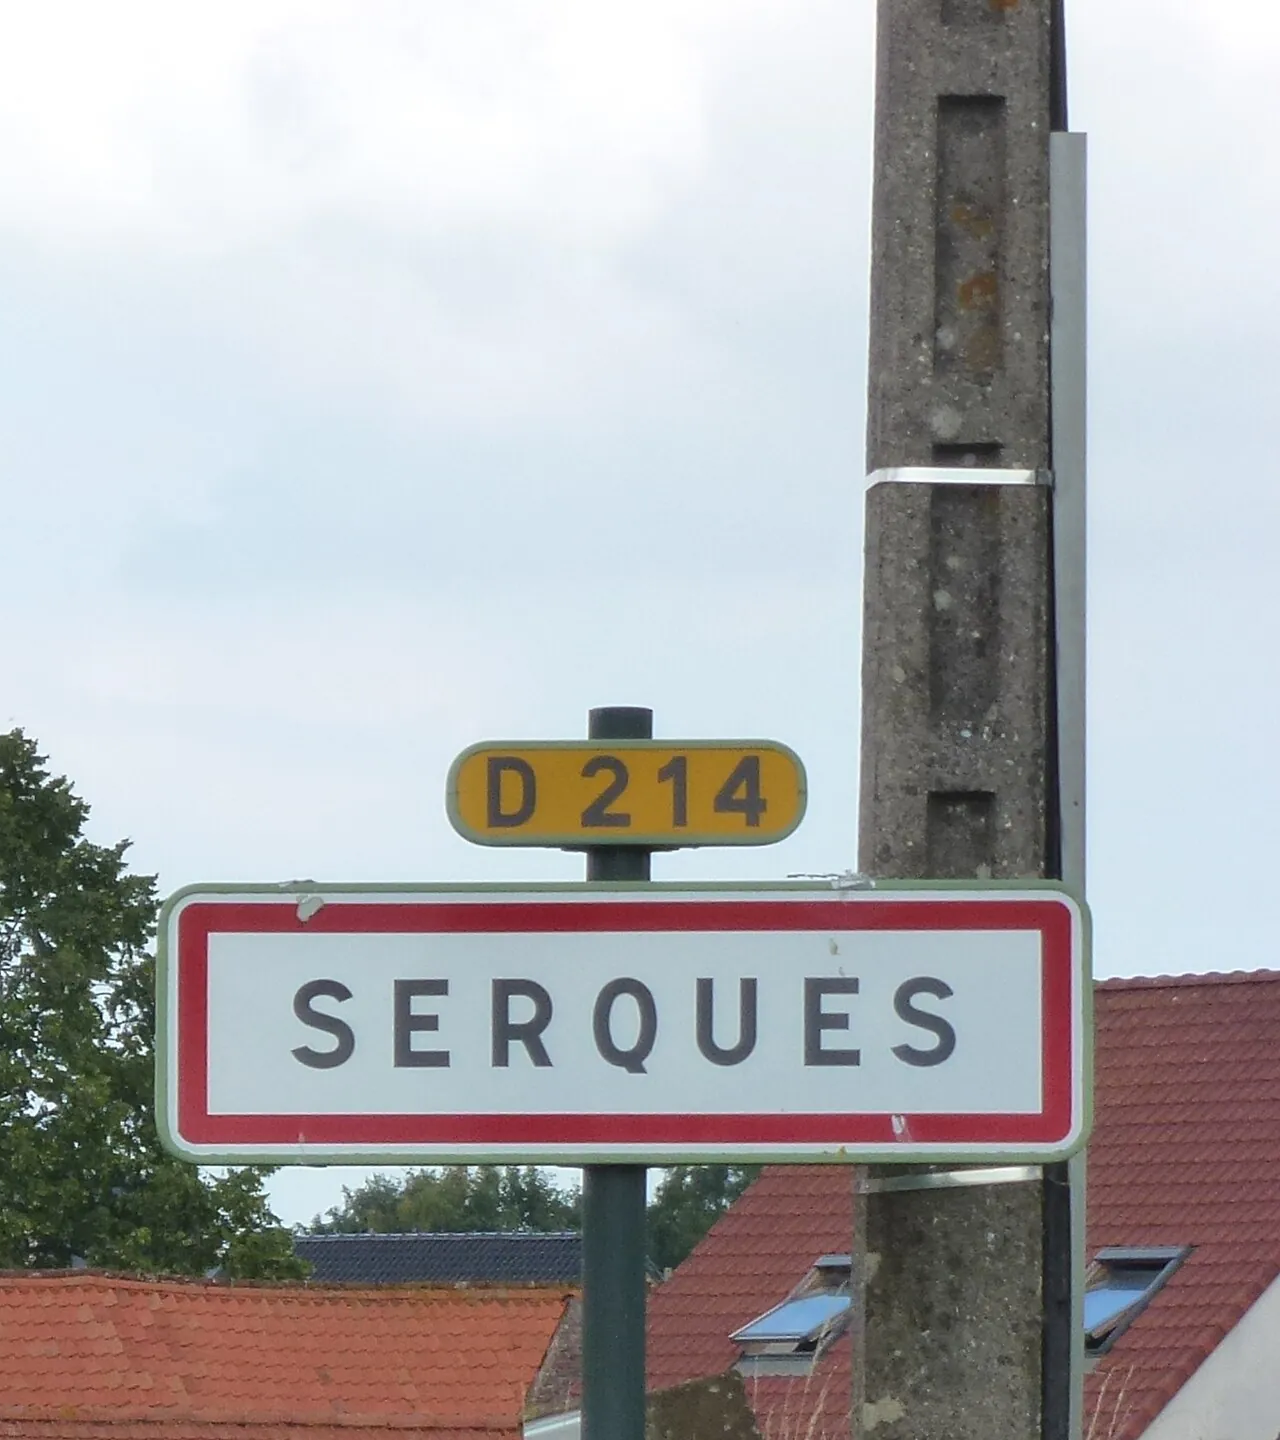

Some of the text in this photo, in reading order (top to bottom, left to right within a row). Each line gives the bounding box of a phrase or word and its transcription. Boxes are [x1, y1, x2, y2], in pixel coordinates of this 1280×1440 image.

[486, 755, 768, 828] D 214
[290, 976, 957, 1074] SERQUES
